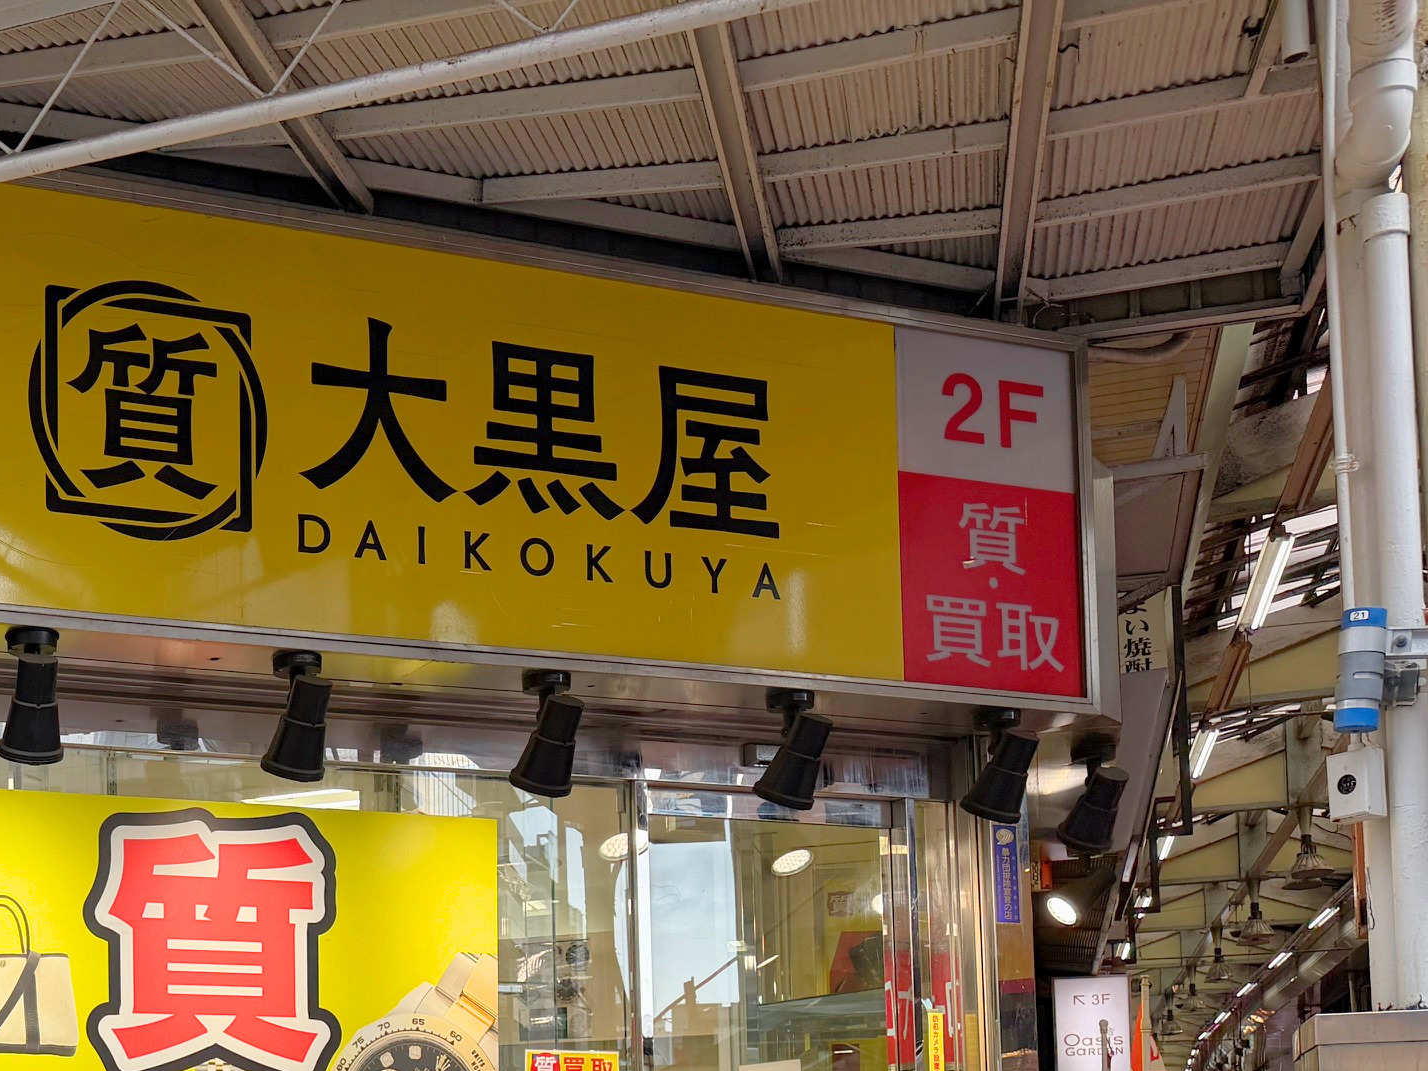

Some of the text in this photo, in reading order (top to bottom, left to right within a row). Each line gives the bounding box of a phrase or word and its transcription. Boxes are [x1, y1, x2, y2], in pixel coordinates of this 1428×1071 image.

[67, 316, 780, 540] 質 大黒屋
[941, 372, 1044, 449] 2F
[298, 513, 780, 600] DAIKOKUYA
[958, 502, 1026, 575] 質
[926, 594, 1065, 672] 買取
[1353, 612, 1366, 620] 21
[1091, 994, 1110, 1005] 3F
